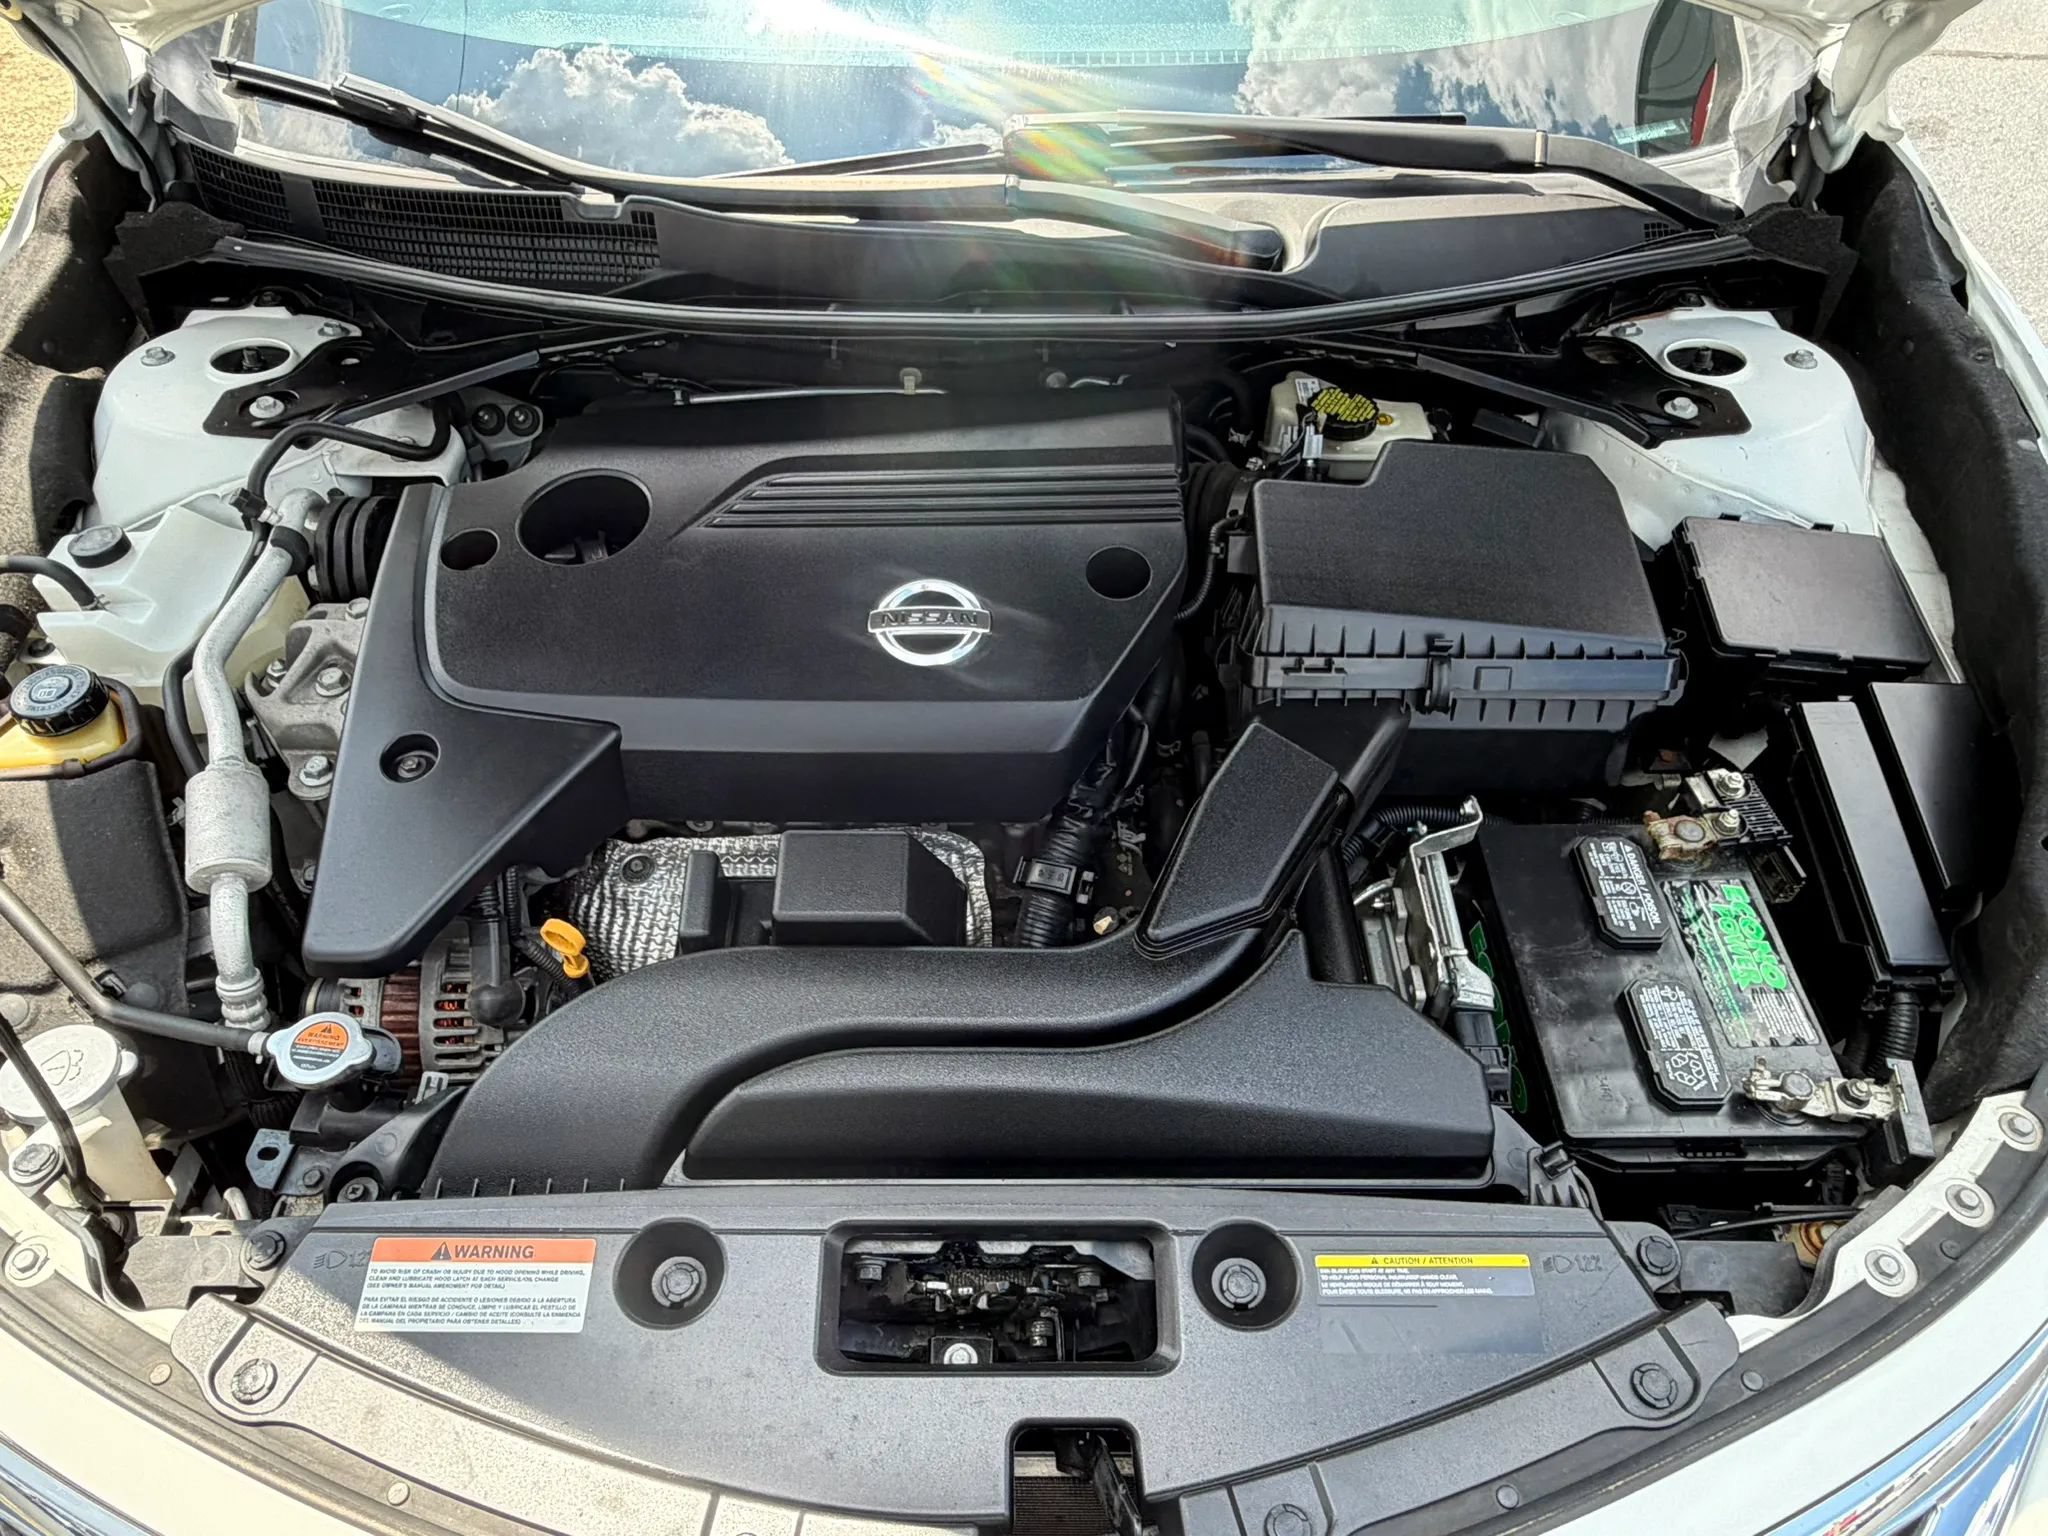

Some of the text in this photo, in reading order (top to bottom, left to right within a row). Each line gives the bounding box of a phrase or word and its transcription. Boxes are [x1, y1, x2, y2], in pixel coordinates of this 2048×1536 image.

[881, 611, 978, 627] NISSAN
[1627, 852, 1647, 886] DANGER
[1641, 893, 1662, 924] POISON
[1708, 903, 1763, 991] POWER
[1720, 884, 1788, 991] ECONO
[454, 1244, 535, 1259] WARNING
[1383, 1257, 1421, 1265] CAUTION
[1428, 1257, 1474, 1265] ATTENTION
